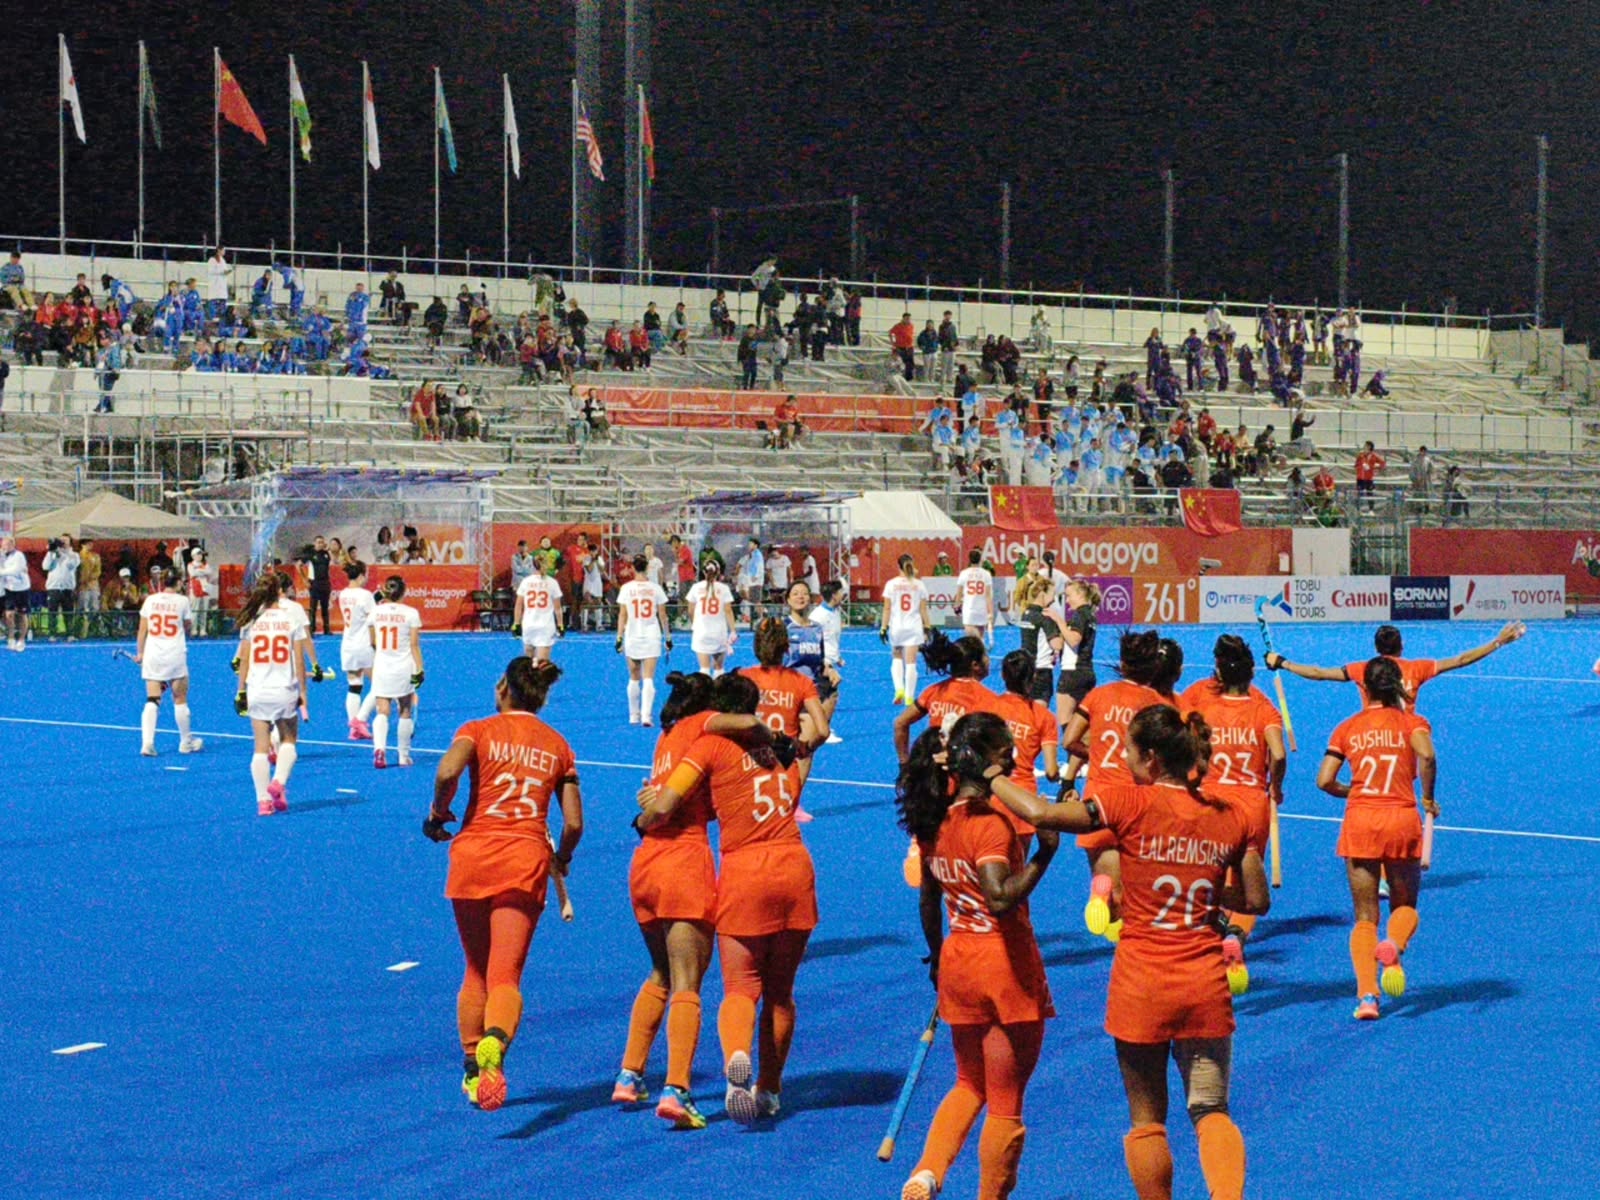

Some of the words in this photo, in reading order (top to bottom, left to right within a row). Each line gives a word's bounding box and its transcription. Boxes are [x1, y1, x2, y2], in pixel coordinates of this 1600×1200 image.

[967, 581, 985, 596] 58
[1294, 580, 1321, 591] TOBU
[1394, 588, 1448, 600] BORNAN
[424, 599, 448, 609] 2026
[527, 591, 549, 609] 23
[700, 597, 720, 615] 18
[901, 594, 912, 611] 6
[1106, 597, 1128, 611] 100
[1294, 593, 1314, 605] TOP
[1332, 590, 1389, 608] Canon
[1511, 590, 1562, 604] TOYOTA
[632, 599, 653, 619] 13
[1294, 606, 1327, 618] TOURS
[149, 614, 179, 637] 35
[380, 626, 398, 650] 11
[253, 635, 290, 663] 26
[759, 689, 794, 708] KSHI
[1104, 705, 1133, 724] JYO
[1008, 720, 1031, 741] EET
[1210, 728, 1258, 746] SHIKA
[1350, 730, 1406, 753] SUSHILA
[489, 740, 558, 775] NAVNEET
[1213, 752, 1259, 787] 23
[1359, 754, 1398, 795] 27
[485, 772, 543, 818] 25
[752, 773, 793, 823] 55
[1151, 874, 1214, 931] 20
